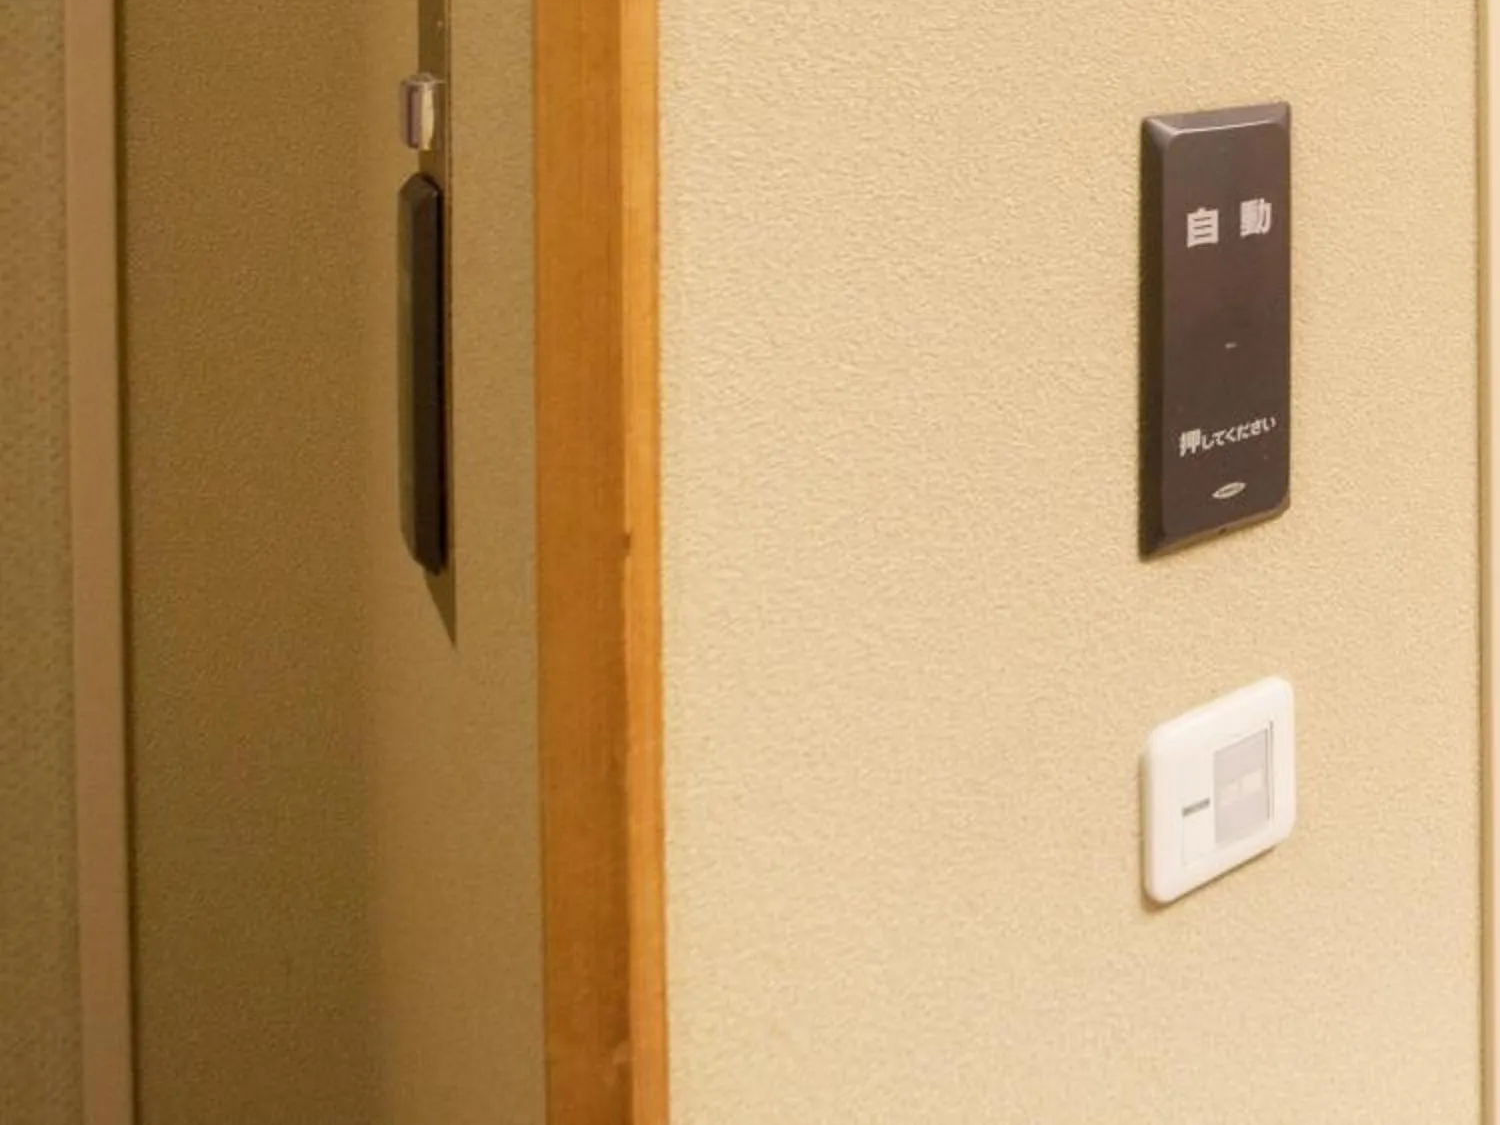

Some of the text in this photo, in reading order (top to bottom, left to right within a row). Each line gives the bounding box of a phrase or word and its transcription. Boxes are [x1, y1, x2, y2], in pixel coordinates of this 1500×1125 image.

[1180, 416, 1276, 457] 押してください
